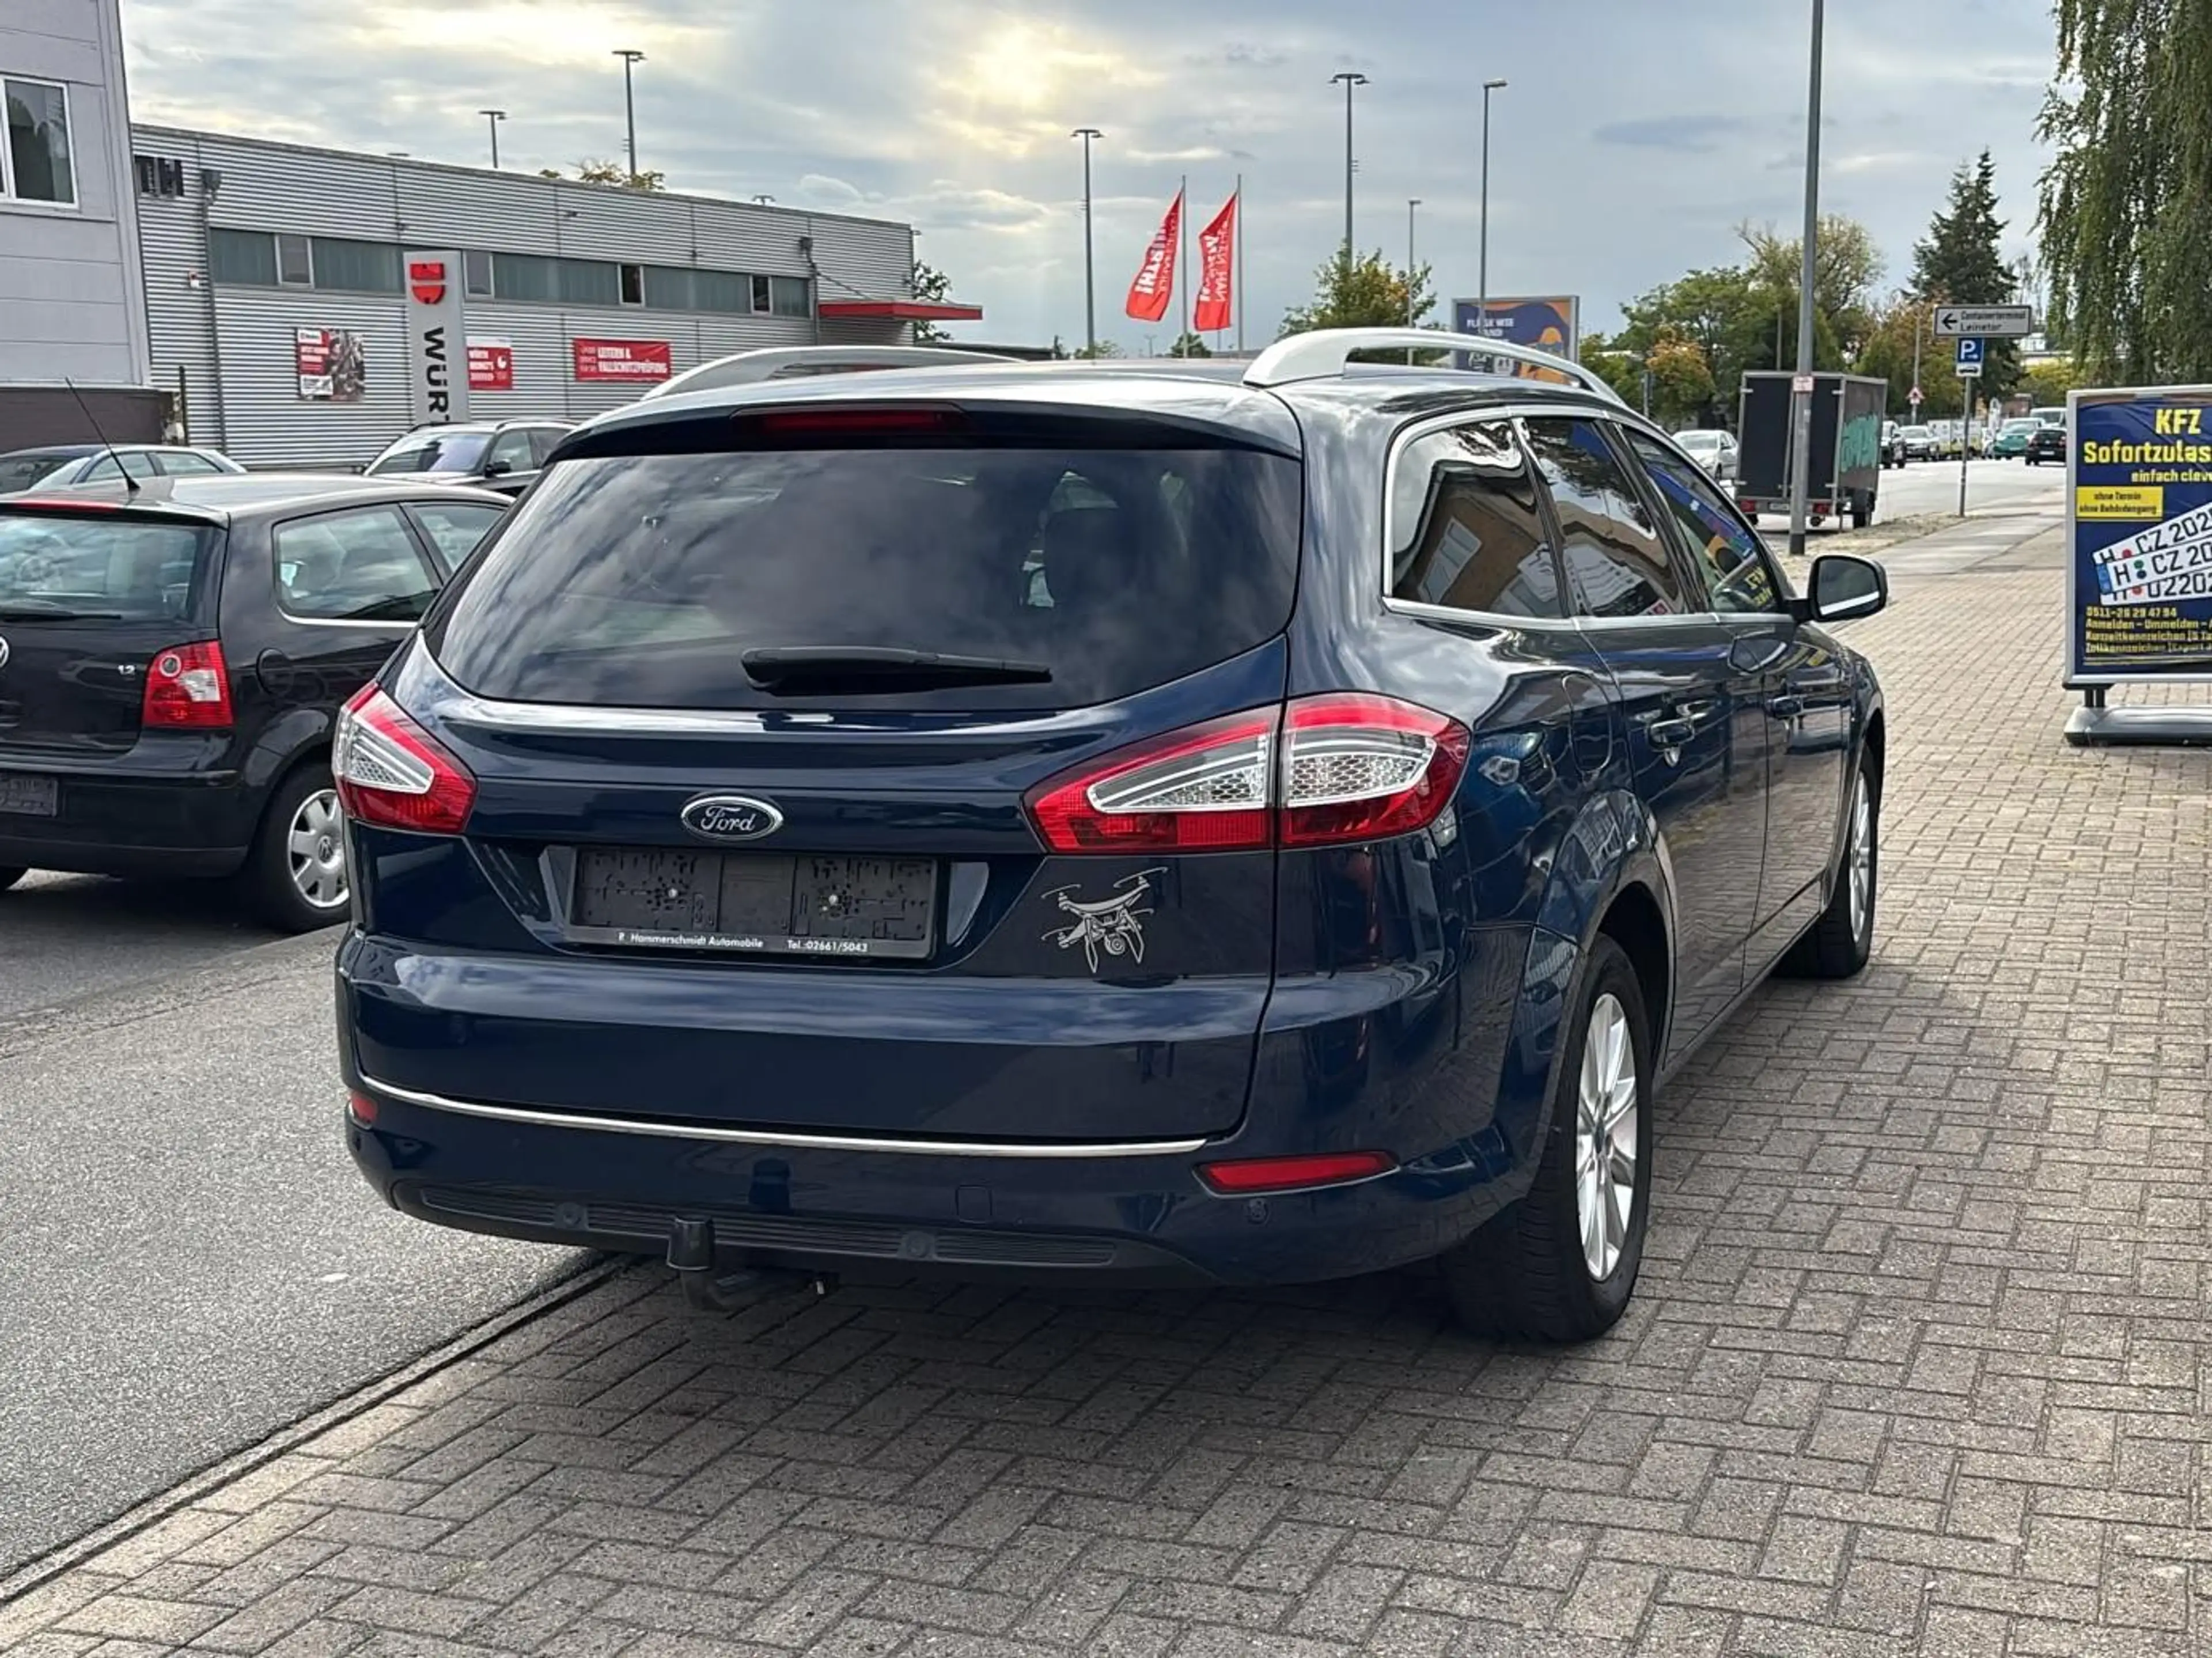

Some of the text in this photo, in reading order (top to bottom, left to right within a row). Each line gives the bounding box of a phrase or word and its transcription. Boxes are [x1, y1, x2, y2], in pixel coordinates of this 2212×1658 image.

[1960, 340, 1976, 359] P
[423, 326, 450, 422] WÜR
[2156, 408, 2202, 434] KFZ
[2131, 469, 2178, 483] einfach
[2135, 529, 2168, 554] CZ
[2113, 563, 2131, 586] H
[2152, 550, 2184, 575] CZ
[2086, 618, 2135, 629] Anmelden
[2145, 619, 2199, 629] Ummelden
[700, 806, 757, 831] Ford
[708, 936, 764, 948] Automobile
